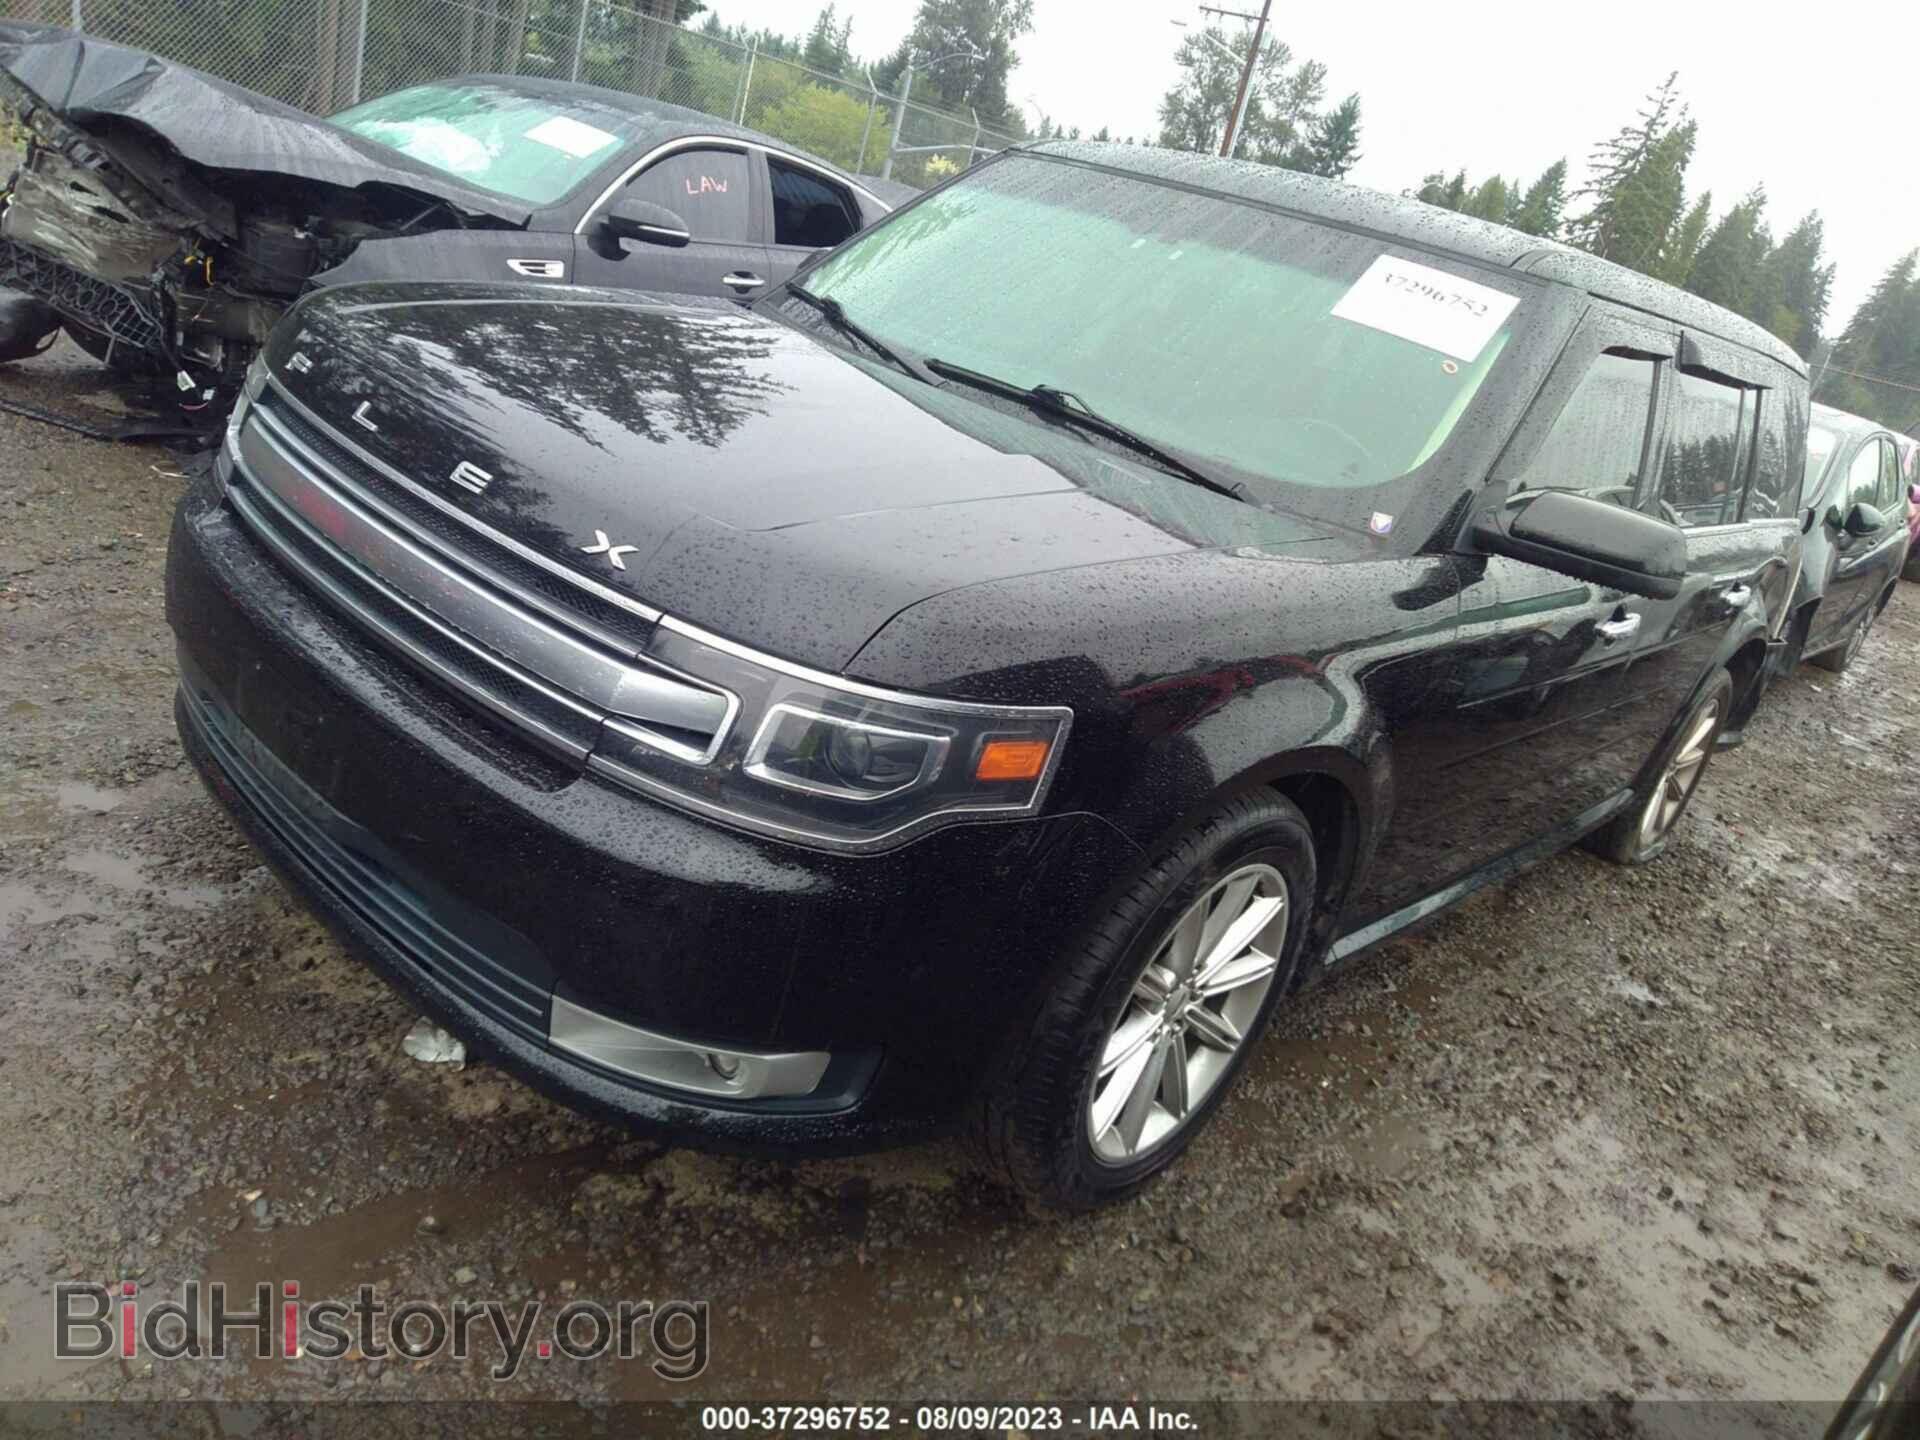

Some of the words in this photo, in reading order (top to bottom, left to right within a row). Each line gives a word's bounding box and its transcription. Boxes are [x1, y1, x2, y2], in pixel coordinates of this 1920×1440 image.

[685, 175, 728, 194] LAW
[1382, 272, 1489, 317] 37296752
[283, 351, 640, 571] FLEX
